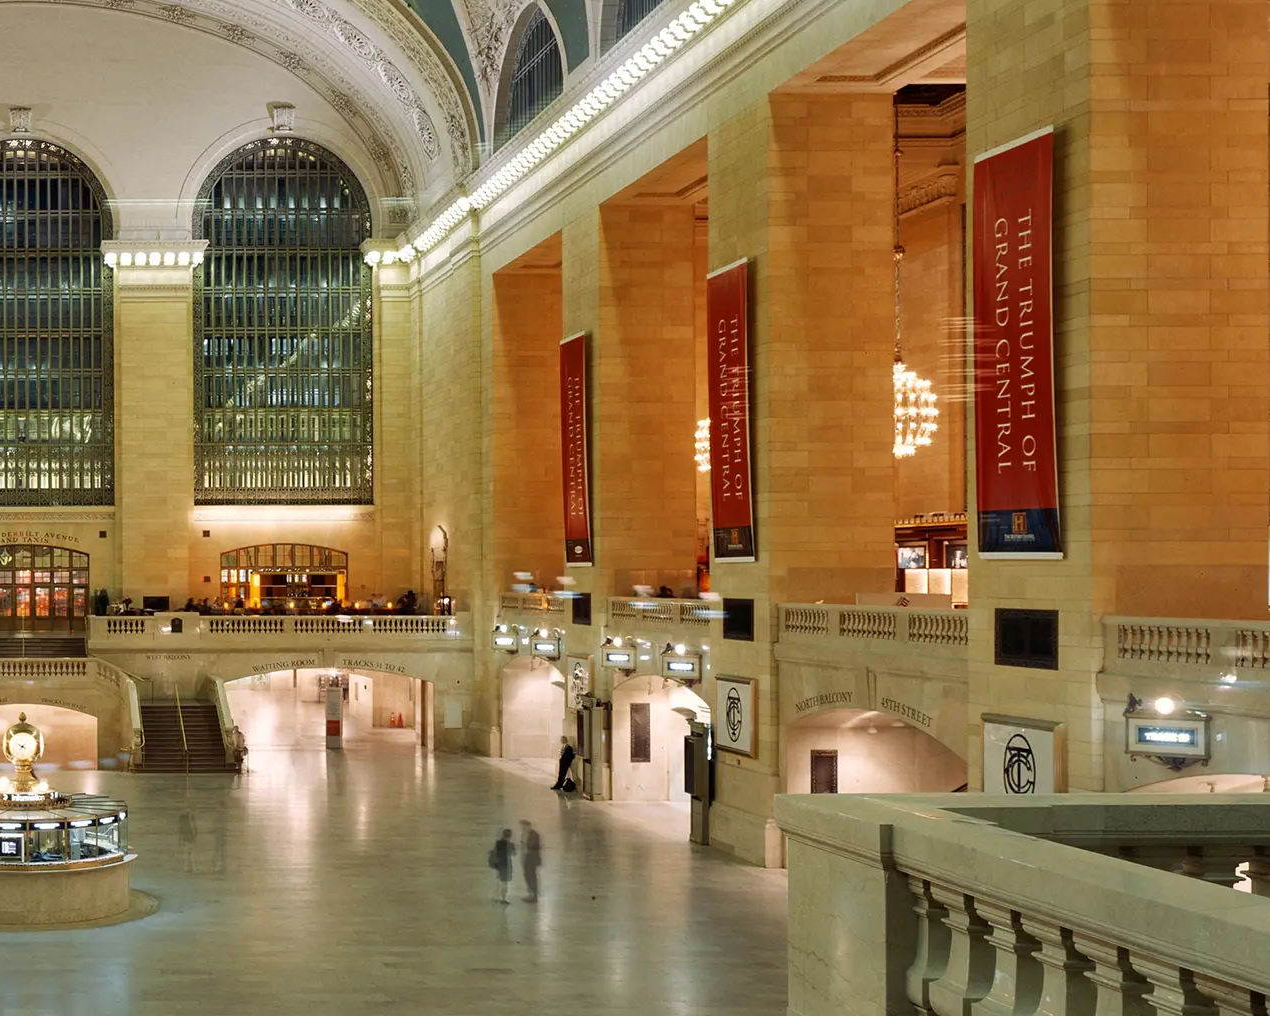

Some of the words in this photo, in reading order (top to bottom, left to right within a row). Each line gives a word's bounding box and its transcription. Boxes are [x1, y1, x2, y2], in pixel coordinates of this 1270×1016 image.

[1017, 208, 1033, 270] THE
[994, 217, 1010, 327] GRAND
[730, 315, 739, 356] THE
[1018, 279, 1036, 421] TRIUMPH
[718, 318, 728, 397] GRAND
[995, 338, 1012, 475] CENTRAL
[720, 405, 731, 503] CENTRAL
[1021, 435, 1037, 472] OF
[734, 473, 743, 500] OF
[44, 532, 79, 543] AVENUE
[252, 661, 289, 673] WAITING
[291, 659, 315, 667] ROOM
[342, 659, 374, 668] TRACKS
[385, 663, 396, 672] TO
[795, 695, 819, 713] NORTH
[819, 691, 853, 705] BALCONY
[880, 697, 901, 714] 45TH
[901, 704, 933, 727] STREET
